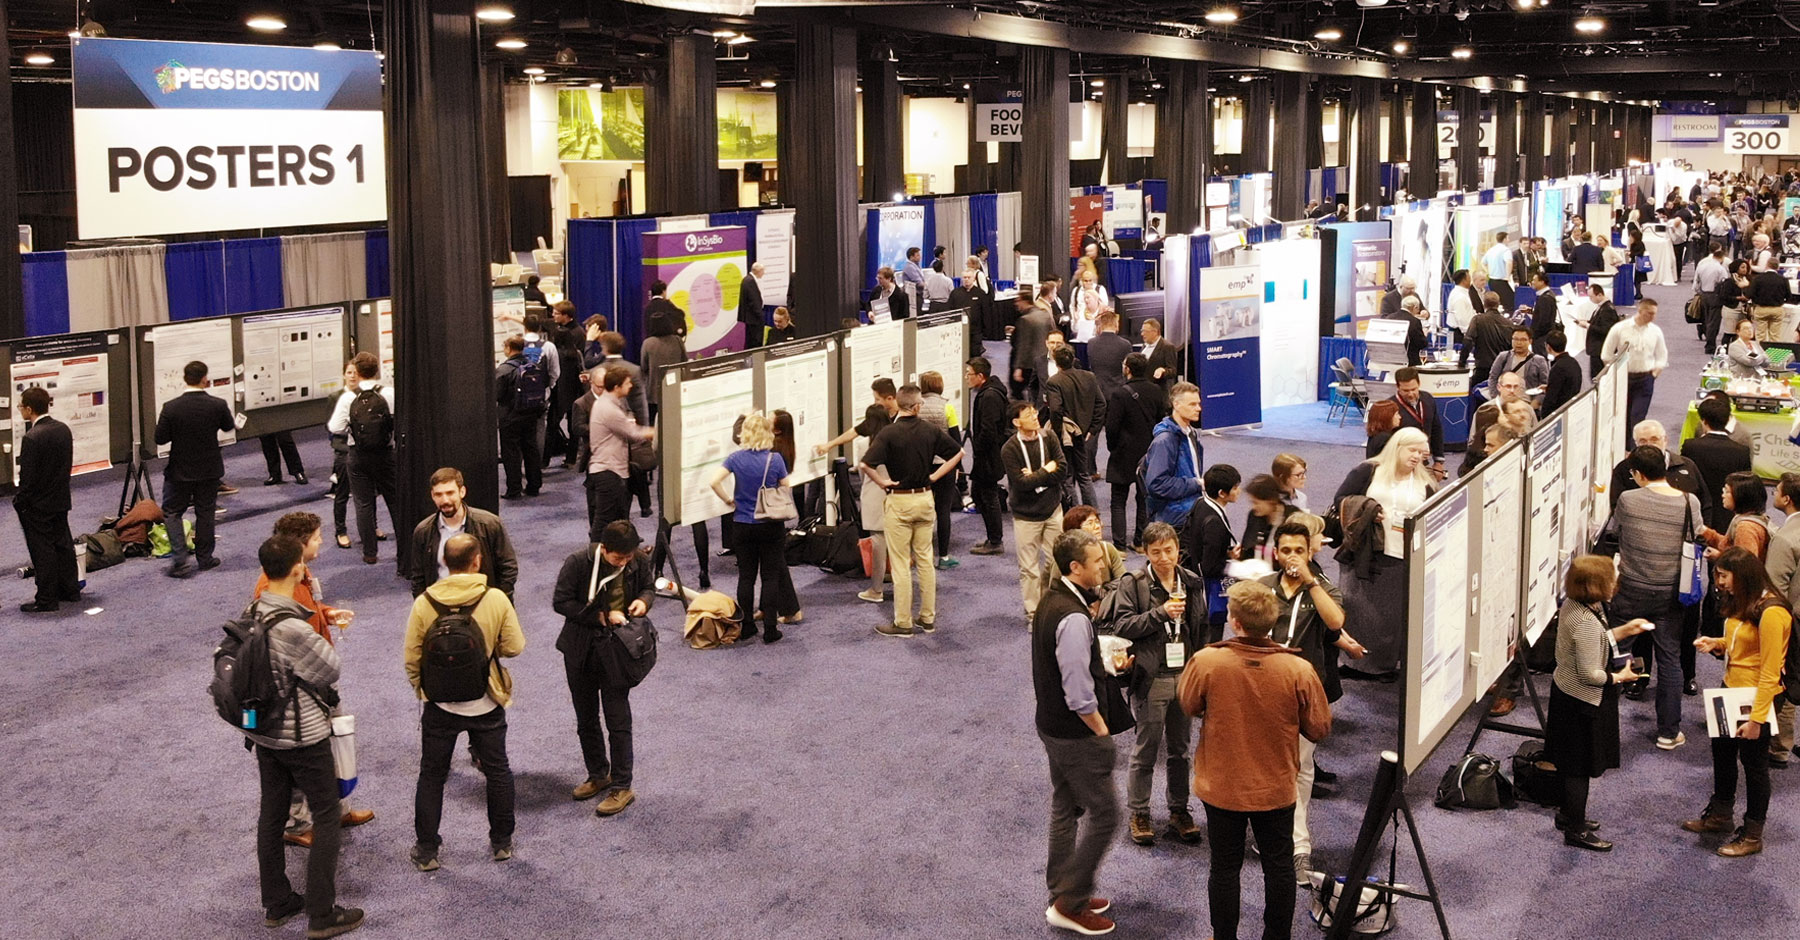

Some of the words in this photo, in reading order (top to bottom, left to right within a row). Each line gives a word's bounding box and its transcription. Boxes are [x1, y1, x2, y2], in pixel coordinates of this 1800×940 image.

[174, 67, 320, 92] PEGSBOSTON
[991, 109, 1021, 121] FOO
[1673, 123, 1717, 131] RESTROOM
[1738, 118, 1780, 126] PEGSBOSTON
[991, 124, 1022, 135] BEV
[1731, 131, 1781, 150] 300
[107, 143, 335, 194] POSTERS
[346, 143, 365, 184] 1
[1228, 280, 1246, 291] emp
[1442, 379, 1460, 388] emp
